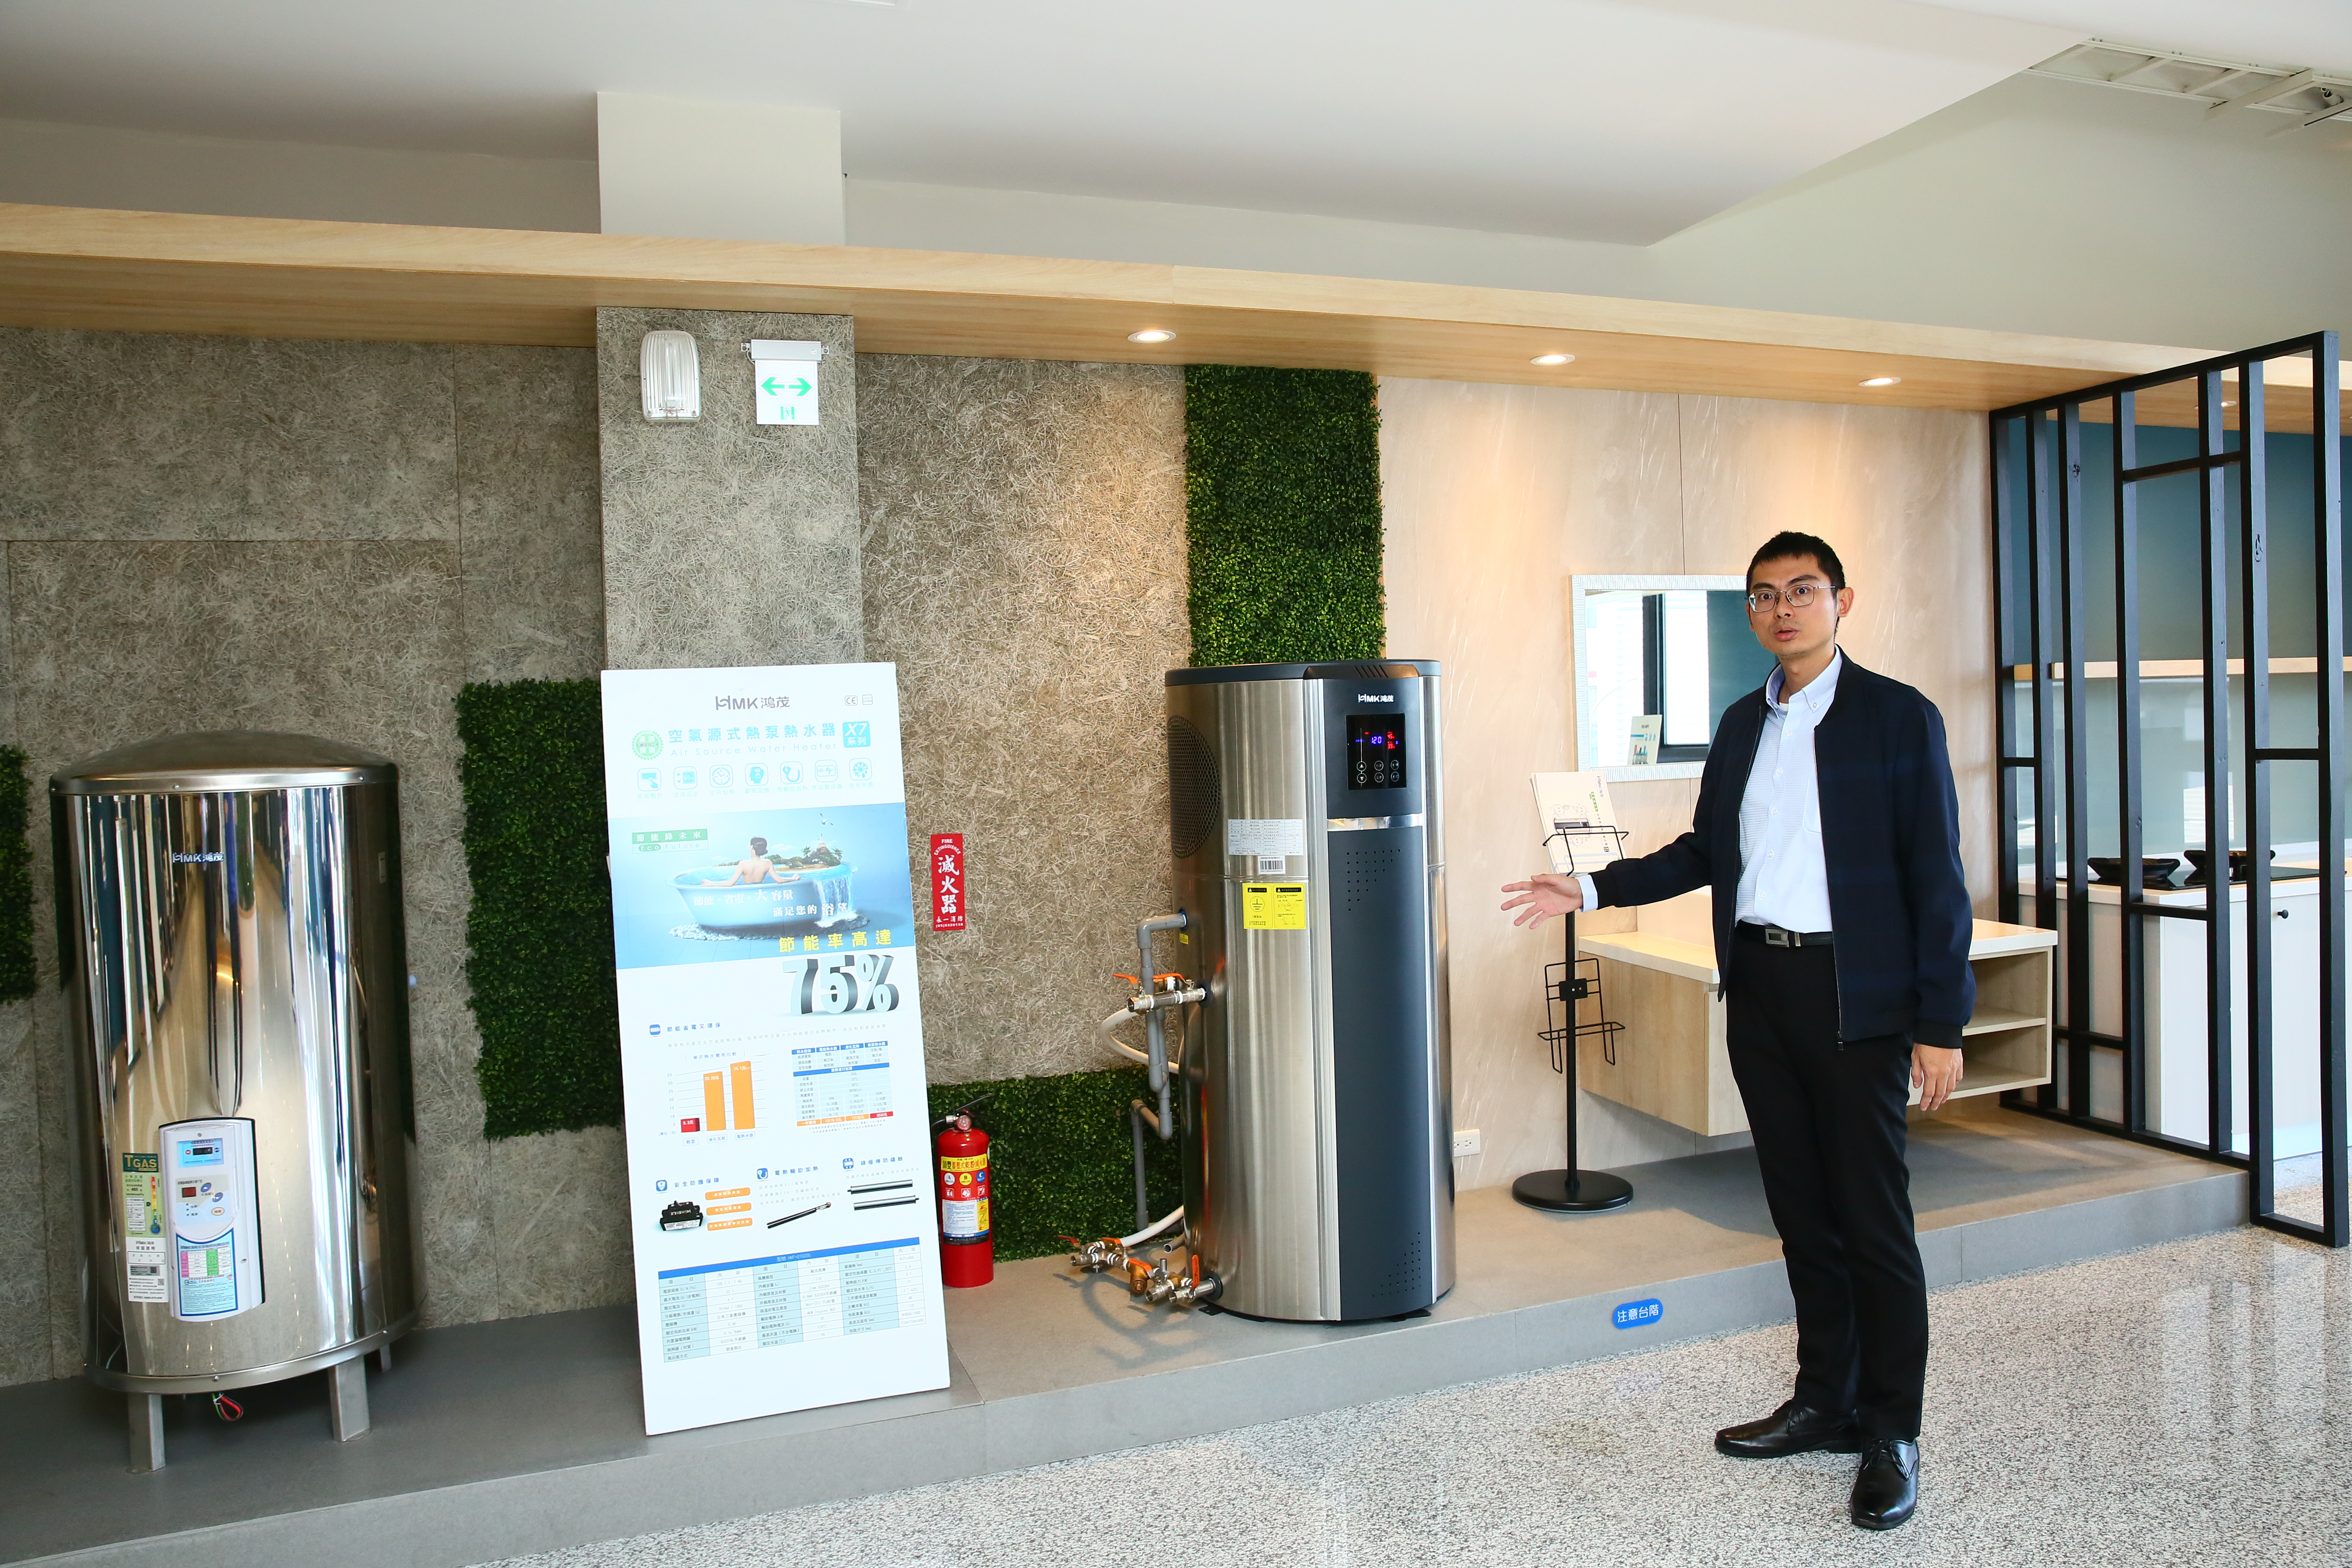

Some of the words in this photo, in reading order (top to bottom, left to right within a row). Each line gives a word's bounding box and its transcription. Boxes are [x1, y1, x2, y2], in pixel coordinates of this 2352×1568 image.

[669, 723, 835, 743] 空氣源式熱泵熱水器
[844, 723, 867, 736] X7
[847, 737, 866, 746] 系列
[671, 748, 688, 757] Air
[696, 746, 741, 756] Source
[748, 744, 786, 753] Water
[793, 742, 837, 752] Heater
[636, 831, 701, 842] 節能綠未來
[934, 844, 961, 855] EXTINGUISHER
[938, 855, 960, 914] 滅火器
[779, 929, 892, 953] 節能率高達
[782, 954, 900, 1015] 75%
[667, 1022, 721, 1032] 節能省電又環保
[124, 1154, 157, 1168] TGAS
[674, 1178, 719, 1187] 安全防護保障
[1617, 1304, 1659, 1323] 注意台階
